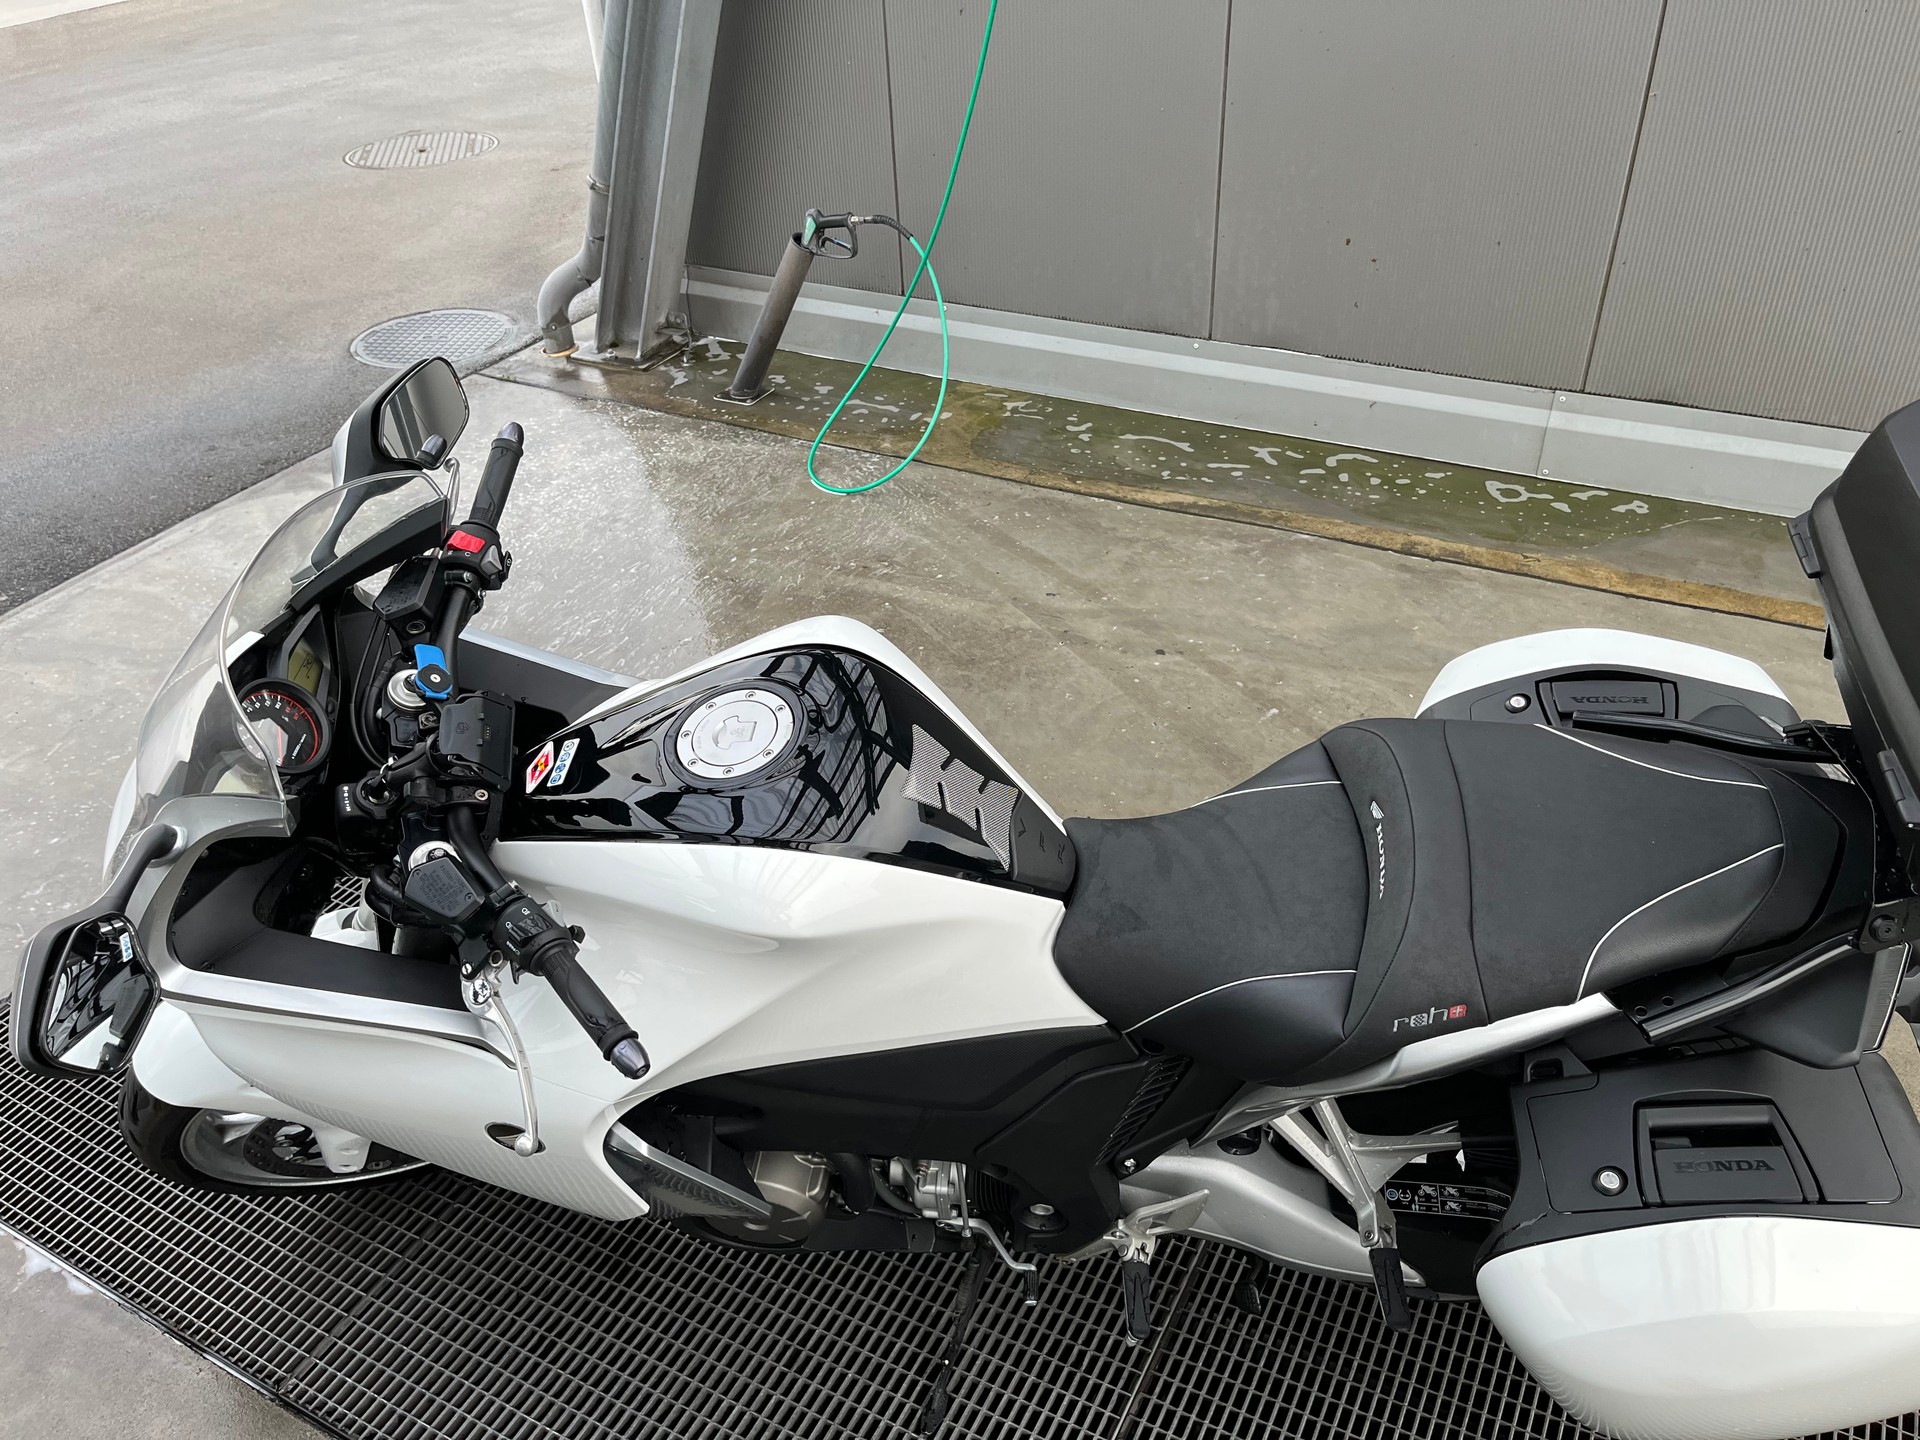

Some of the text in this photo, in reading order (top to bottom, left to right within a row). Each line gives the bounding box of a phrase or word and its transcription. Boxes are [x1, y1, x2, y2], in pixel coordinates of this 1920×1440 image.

[1570, 696, 1649, 705] HONDA
[1375, 822, 1386, 900] HONDA
[1672, 1159, 1776, 1174] HONDA
